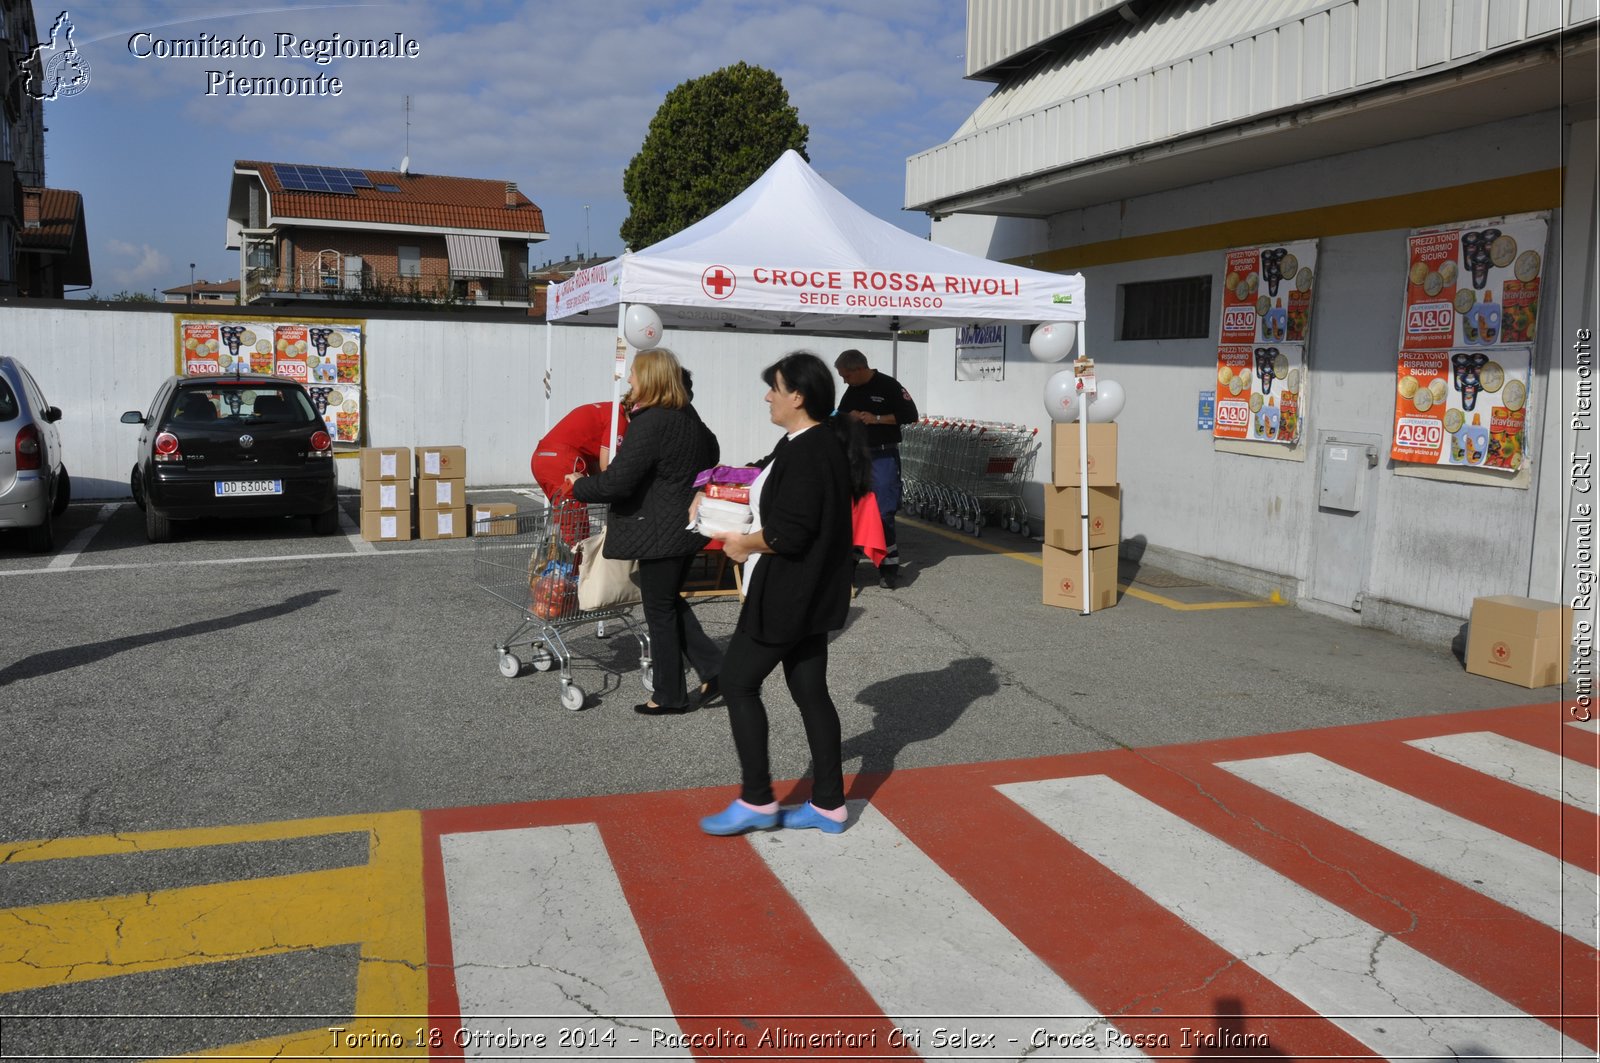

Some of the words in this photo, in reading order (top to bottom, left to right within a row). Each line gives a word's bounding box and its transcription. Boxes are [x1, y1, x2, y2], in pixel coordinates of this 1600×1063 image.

[1410, 237, 1436, 246] PREZZI
[1437, 233, 1459, 242] TONDI
[1415, 243, 1453, 254] RISPARMIO
[1421, 252, 1448, 261] SICURO
[753, 267, 842, 290] CROCE
[853, 270, 937, 293] ROSSA
[945, 276, 1020, 296] RIVOLI
[799, 292, 840, 306] SEDE
[845, 294, 944, 309] GRUGLIASCO
[1225, 313, 1254, 326] A&O
[1409, 310, 1451, 328] A&O
[1398, 352, 1424, 360] PREZZI
[1424, 352, 1449, 360] TONDI
[189, 364, 217, 373] A&O
[278, 365, 305, 374] A&O
[1403, 360, 1443, 368] RISPARMIO
[1410, 368, 1439, 376] SICURO
[1220, 406, 1247, 420] A&O
[1399, 425, 1440, 443] A&O
[224, 482, 237, 492] DD
[241, 481, 274, 491] 630GC
